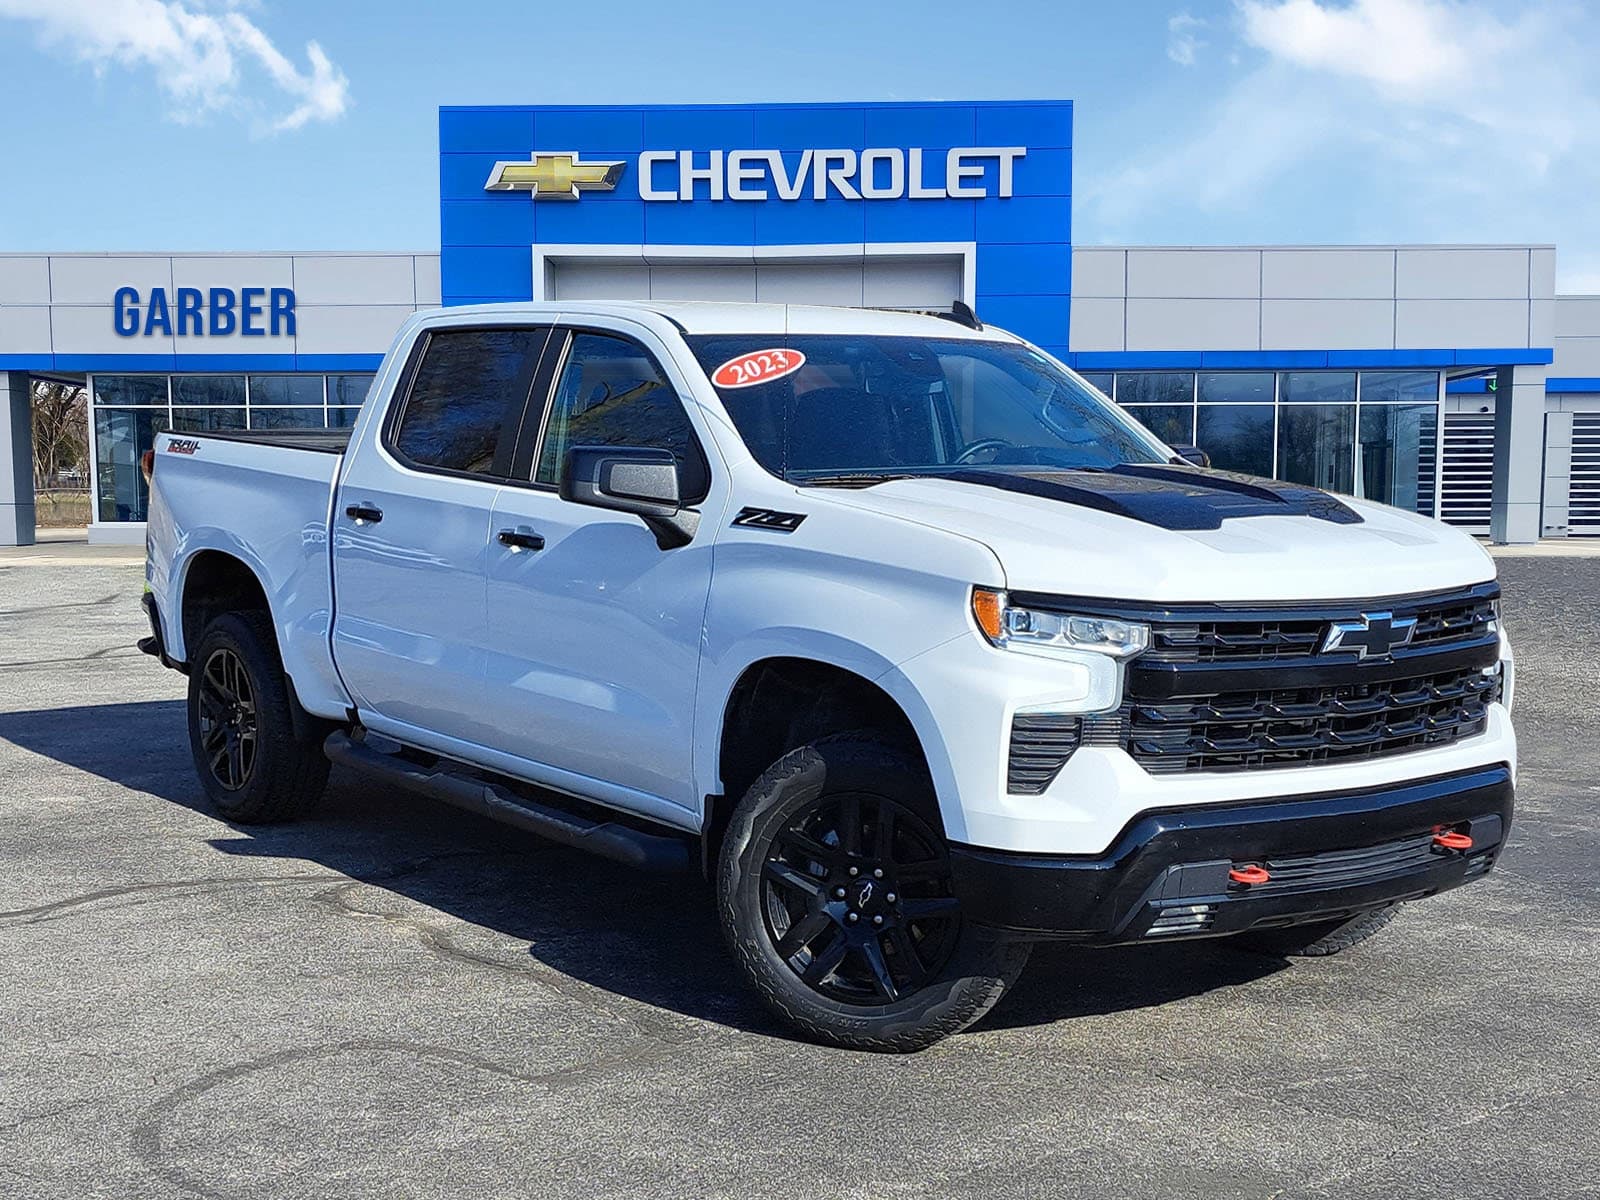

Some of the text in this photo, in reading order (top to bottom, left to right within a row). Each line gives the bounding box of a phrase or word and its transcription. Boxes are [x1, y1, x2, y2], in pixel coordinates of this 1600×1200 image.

[638, 146, 1027, 202] CHEVROLET
[114, 286, 297, 337] GARBER
[728, 350, 789, 384] 2023
